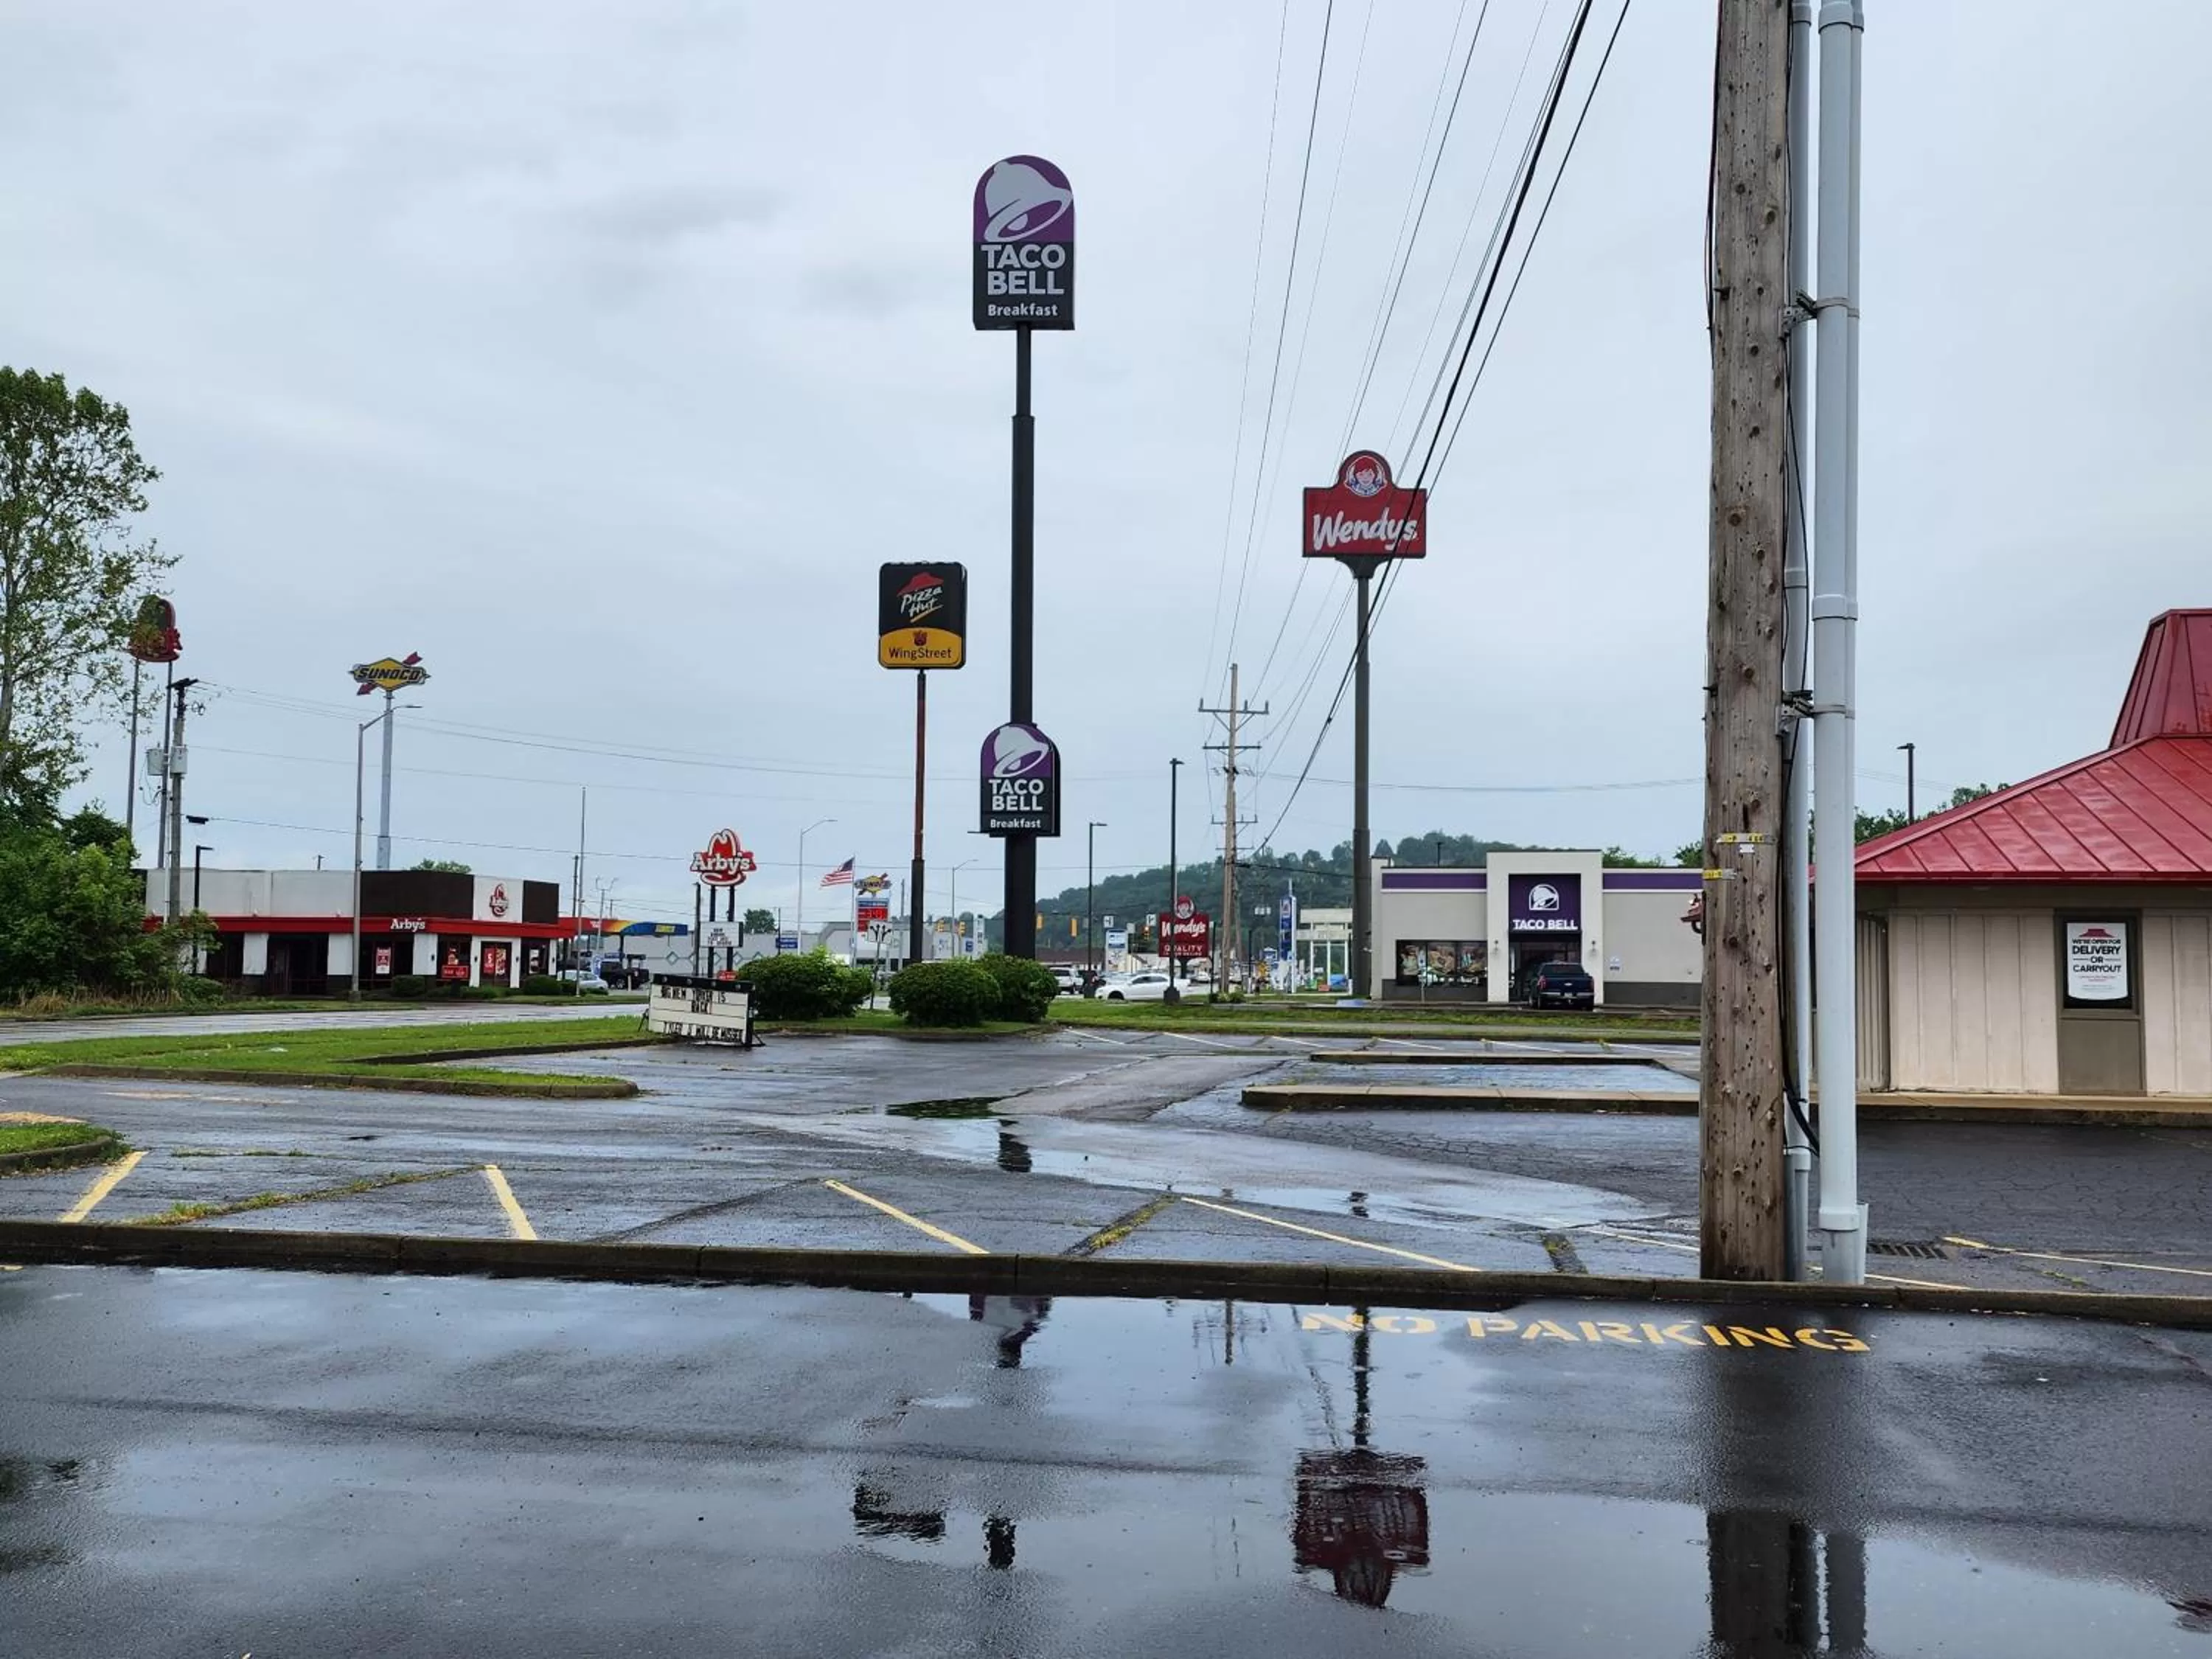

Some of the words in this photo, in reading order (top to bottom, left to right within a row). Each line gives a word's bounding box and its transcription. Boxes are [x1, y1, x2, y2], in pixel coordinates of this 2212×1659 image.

[981, 244, 1065, 269] TACO
[987, 271, 1064, 295] BELL
[988, 303, 1058, 316] Breakfast
[1313, 507, 1417, 550] Wendys
[900, 586, 943, 613] Pizza
[908, 598, 938, 617] Hut
[888, 647, 952, 661] WingStreet
[357, 667, 420, 681] SUNOCO
[988, 779, 1044, 794] TACO
[992, 796, 1043, 811] BELL
[990, 818, 1041, 828] Breakfast
[691, 852, 751, 875] Arby's
[390, 917, 425, 932] Arby's
[1513, 919, 1545, 930] TACO
[1548, 919, 1578, 930] BELL
[2072, 945, 2121, 955] DELIVERY
[2073, 964, 2121, 973] CARRYOUT
[1301, 1312, 1436, 1333] NO
[1467, 1317, 1871, 1352] PARKING
